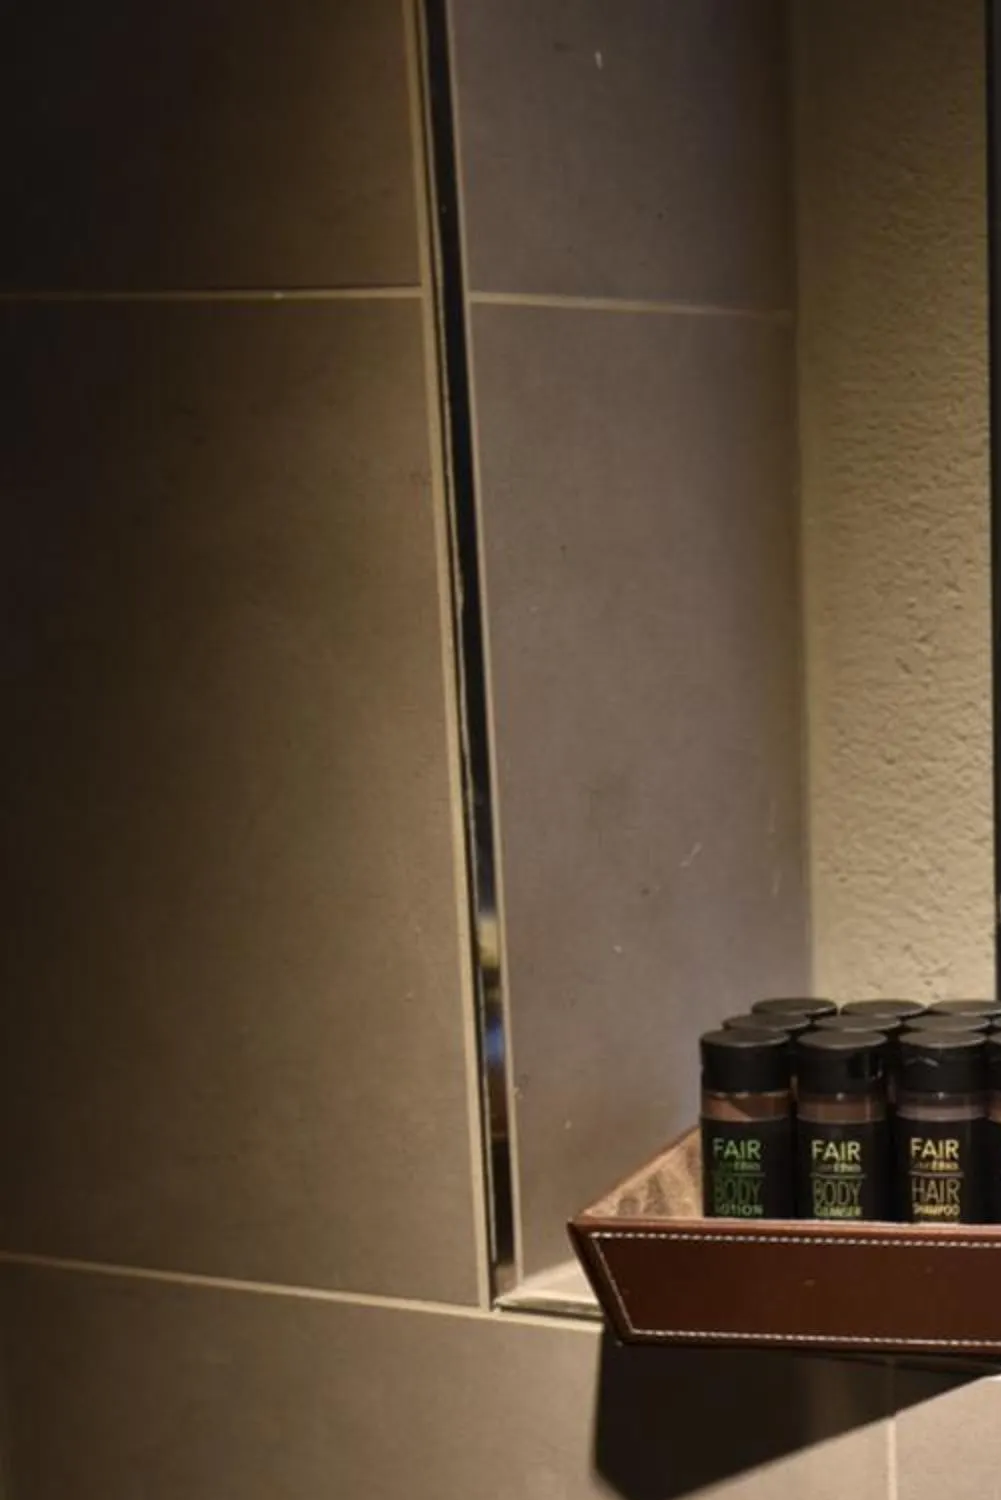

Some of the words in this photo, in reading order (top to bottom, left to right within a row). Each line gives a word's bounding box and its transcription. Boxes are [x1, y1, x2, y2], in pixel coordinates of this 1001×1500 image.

[712, 1137, 762, 1160] FAIR
[811, 1139, 861, 1162] FAIR
[910, 1137, 960, 1160] FAIR
[713, 1177, 763, 1204] BODY
[813, 1178, 863, 1206] BODY
[911, 1176, 961, 1204] HAIR
